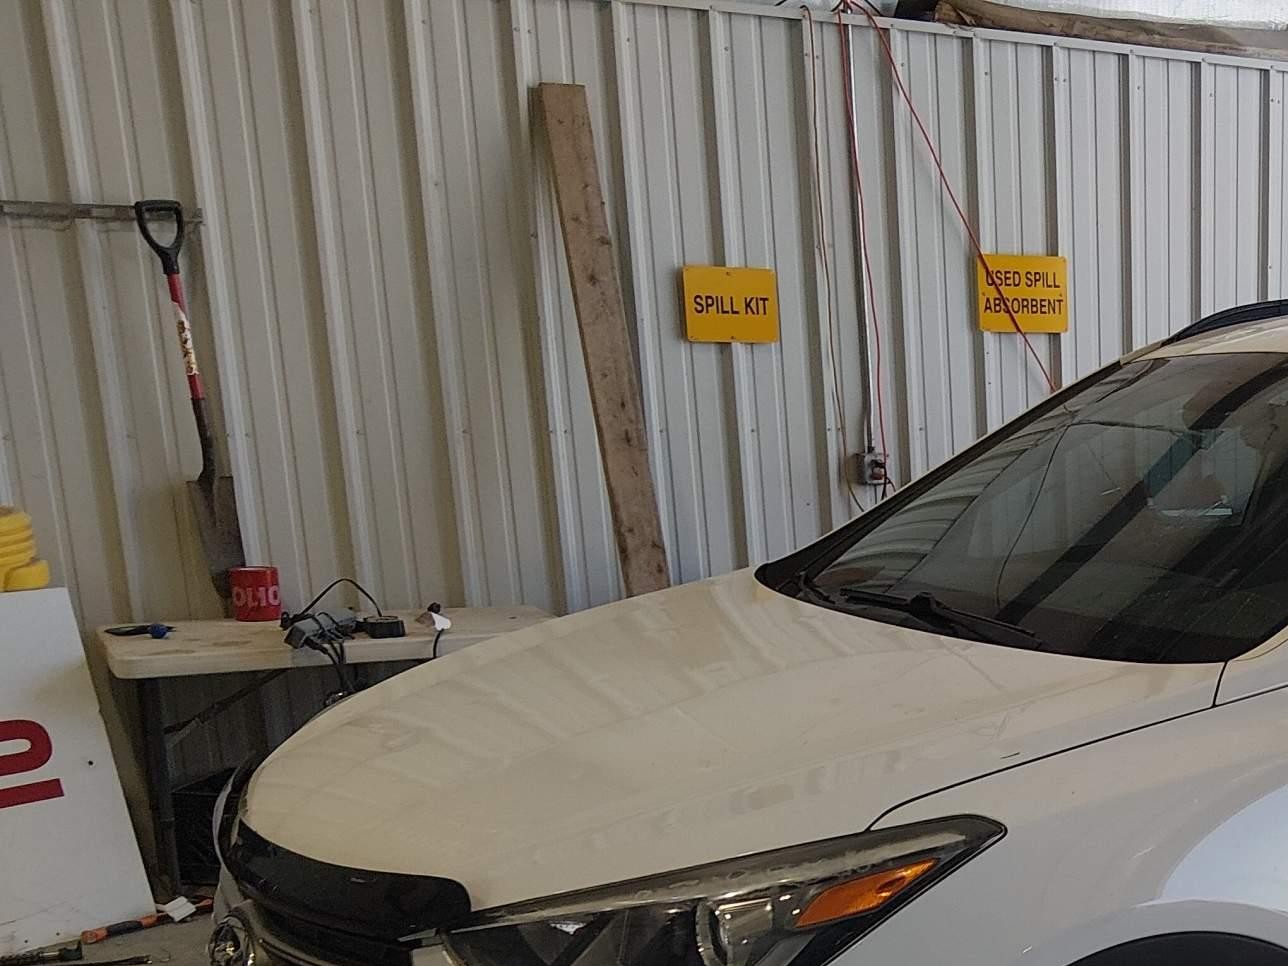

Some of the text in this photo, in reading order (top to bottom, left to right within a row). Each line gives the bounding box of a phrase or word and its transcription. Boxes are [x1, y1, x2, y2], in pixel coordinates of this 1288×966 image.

[985, 270, 1060, 288] USED SPILL
[693, 294, 769, 315] SPILL KIT
[984, 297, 1063, 315] ABSORBENT
